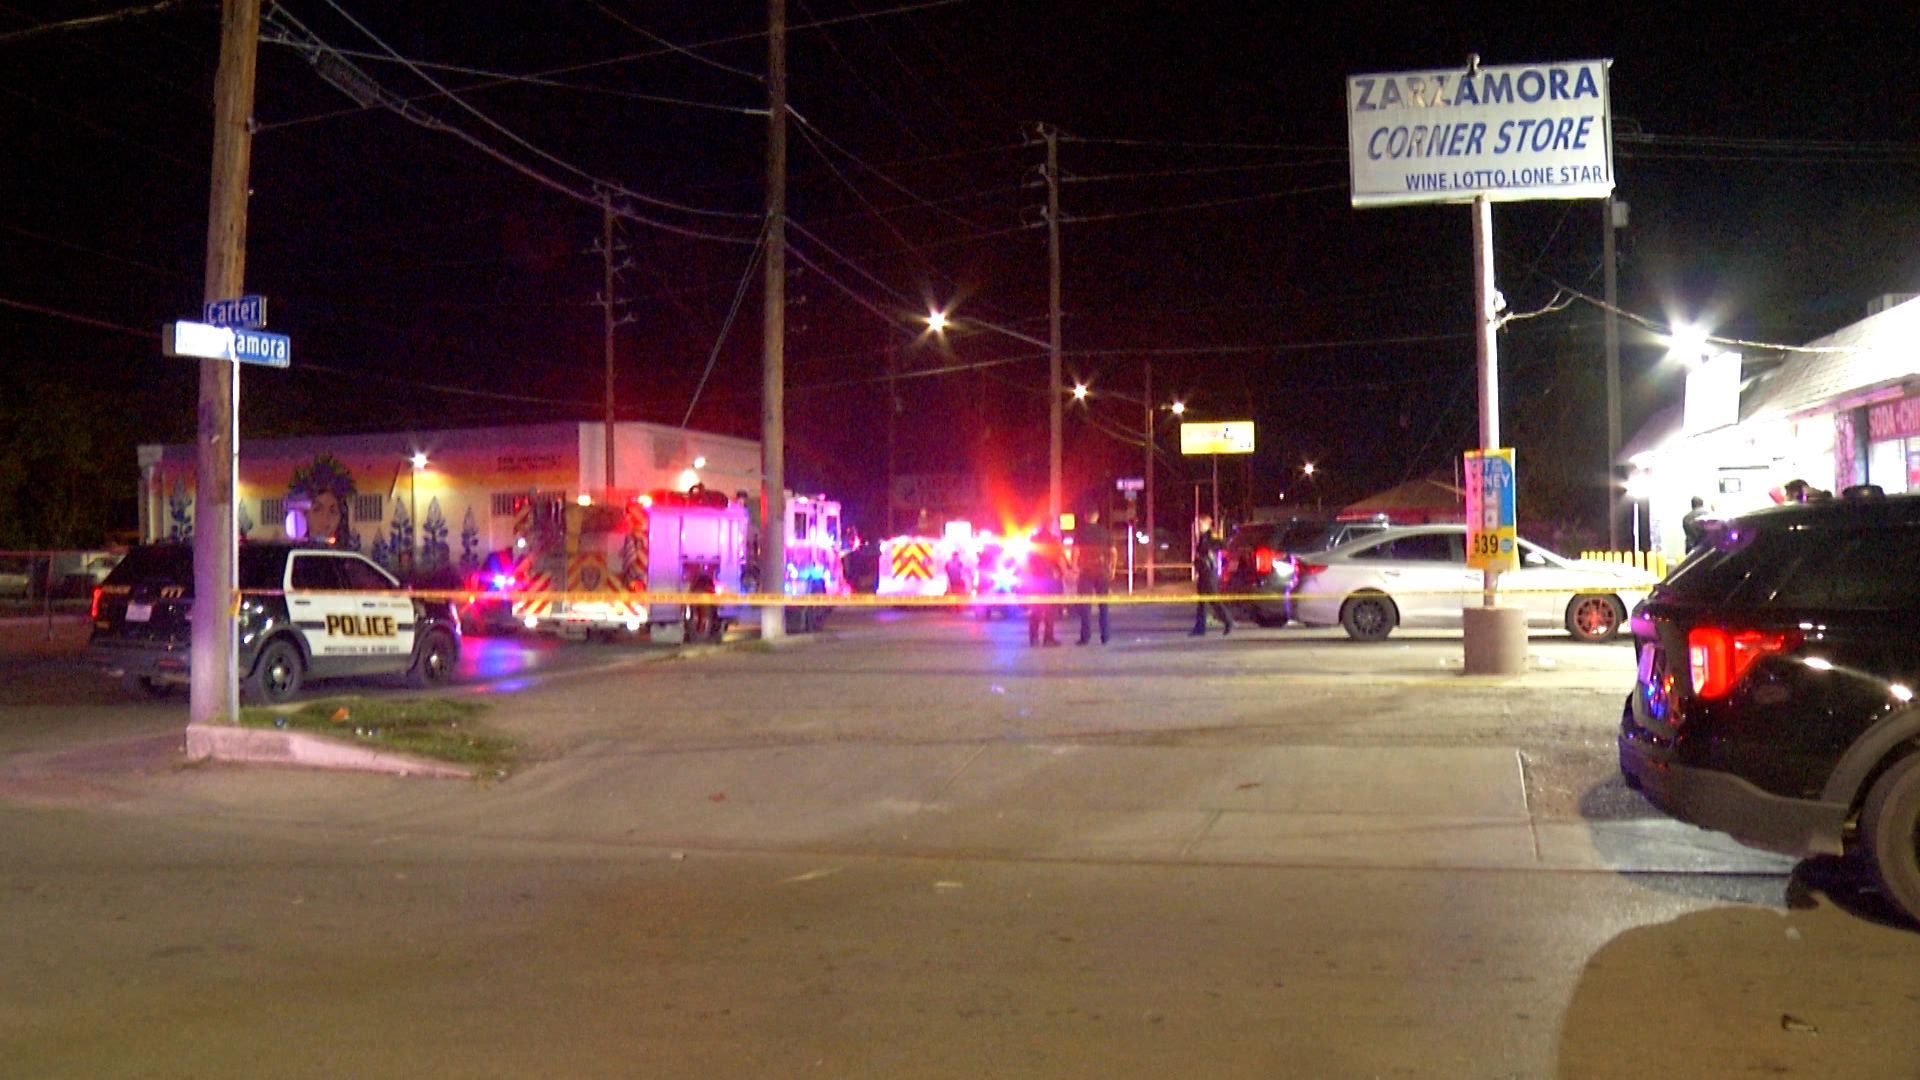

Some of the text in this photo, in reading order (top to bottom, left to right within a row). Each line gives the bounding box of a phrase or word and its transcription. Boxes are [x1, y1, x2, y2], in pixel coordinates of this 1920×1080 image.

[1355, 66, 1599, 111] ZARZAMORA
[1367, 115, 1594, 160] CORNER STORE
[1561, 165, 1604, 184] STAR
[208, 299, 258, 323] Carter
[326, 615, 395, 637] POLICE
